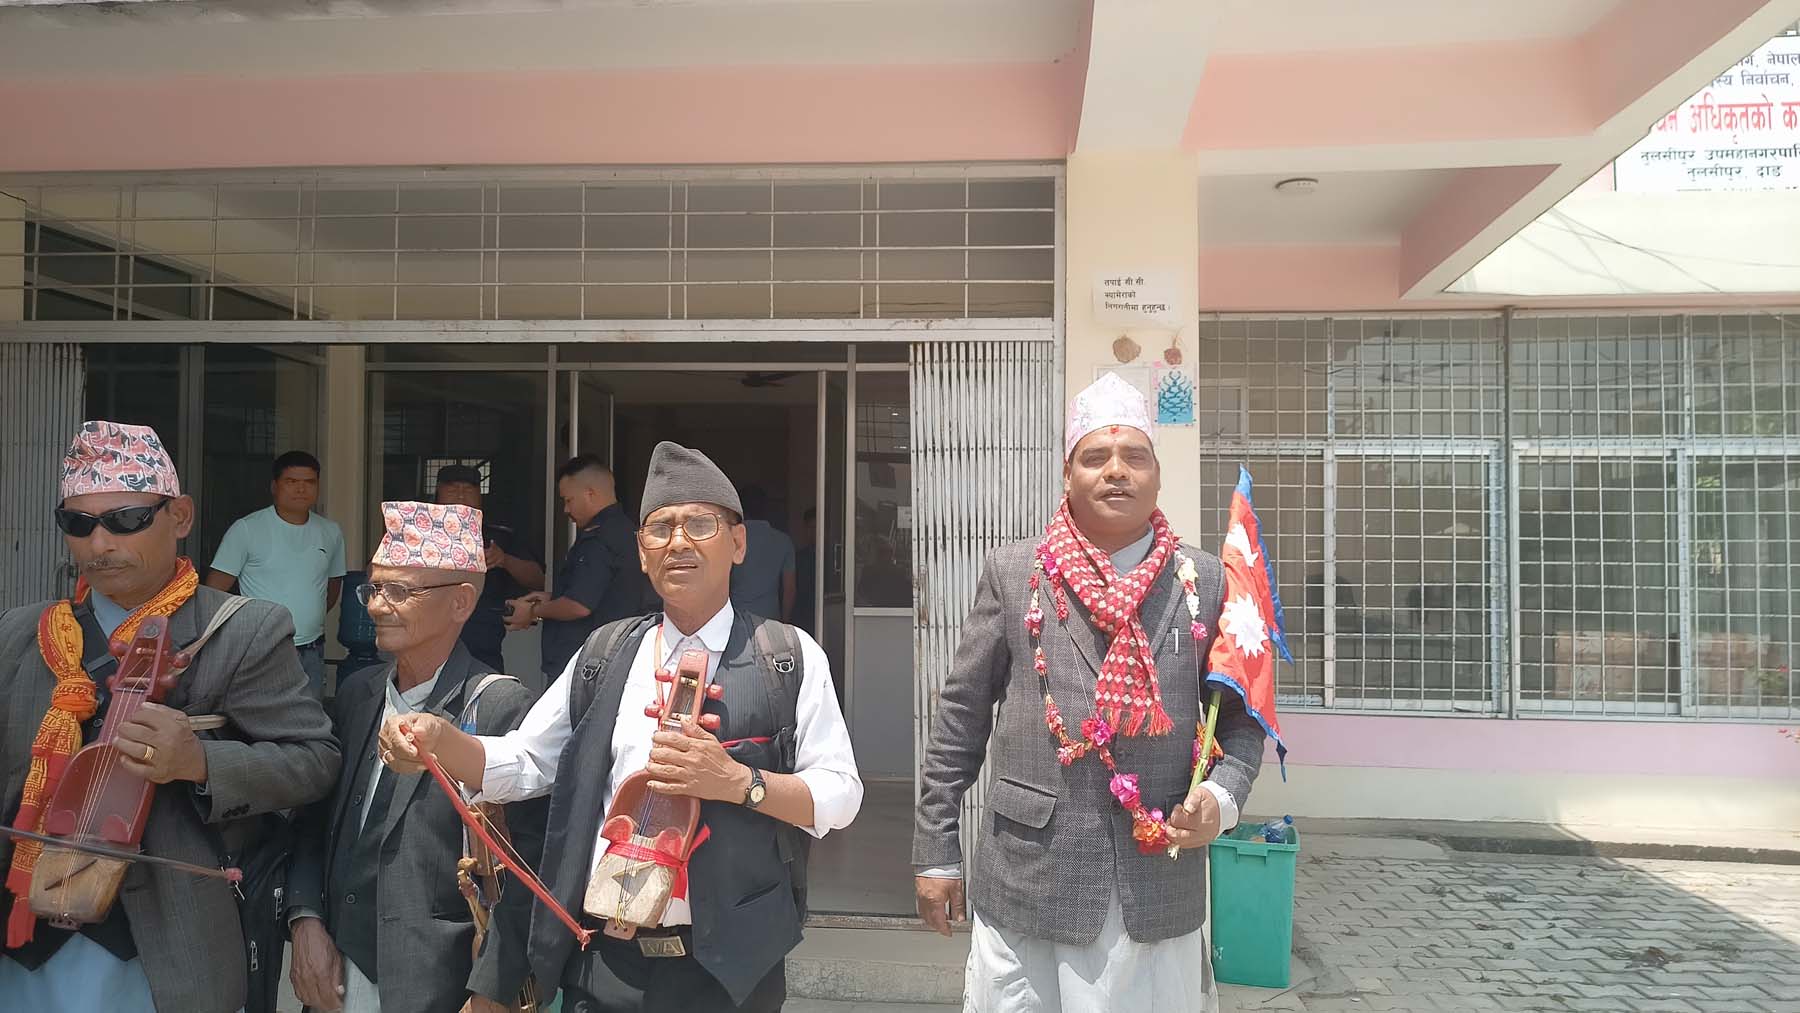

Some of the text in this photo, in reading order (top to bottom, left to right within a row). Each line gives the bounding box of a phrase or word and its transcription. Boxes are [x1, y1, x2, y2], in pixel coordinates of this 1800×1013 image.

[1710, 69, 1795, 88] स्य निर्वाचन,
[1690, 92, 1774, 144] अधिकृतको
[1781, 101, 1800, 131] क
